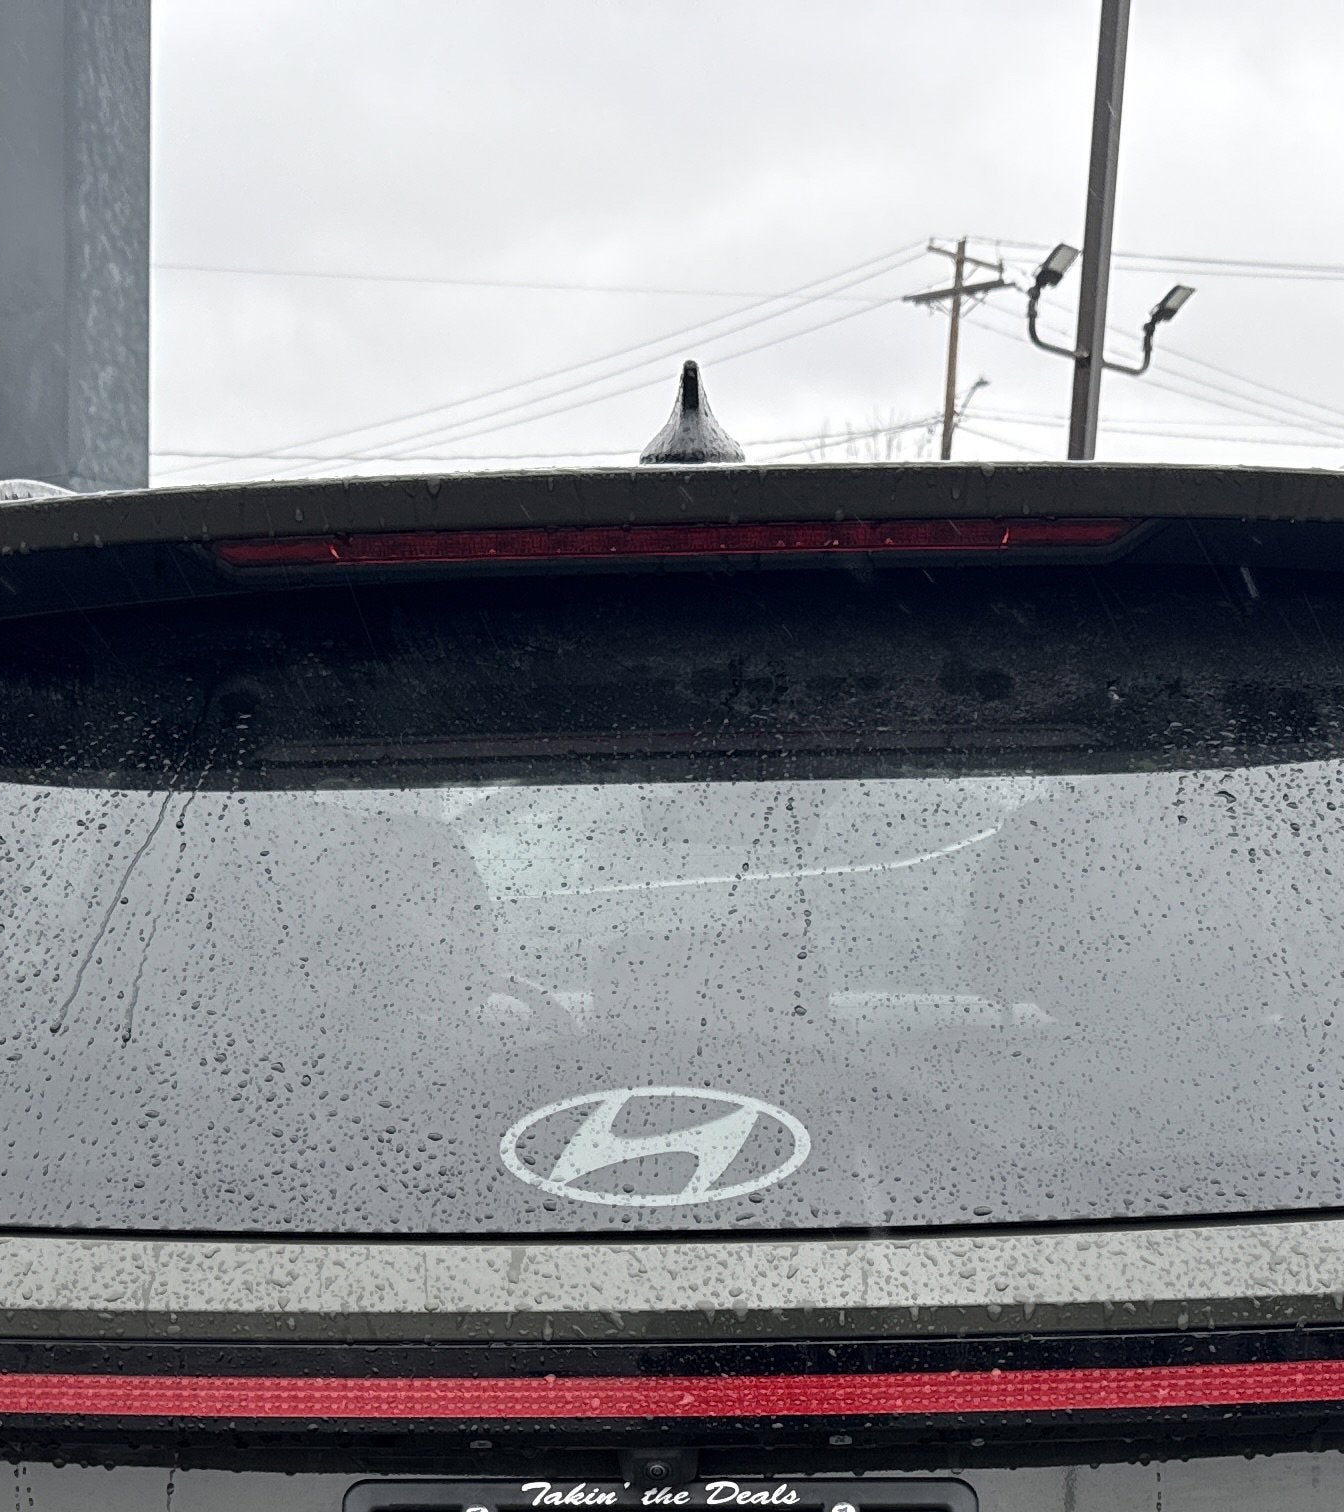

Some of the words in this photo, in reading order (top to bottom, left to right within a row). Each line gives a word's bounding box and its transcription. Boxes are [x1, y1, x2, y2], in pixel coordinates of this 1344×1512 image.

[521, 1480, 631, 1506] Takin'
[641, 1486, 691, 1506] the
[704, 1480, 801, 1506] Deals
